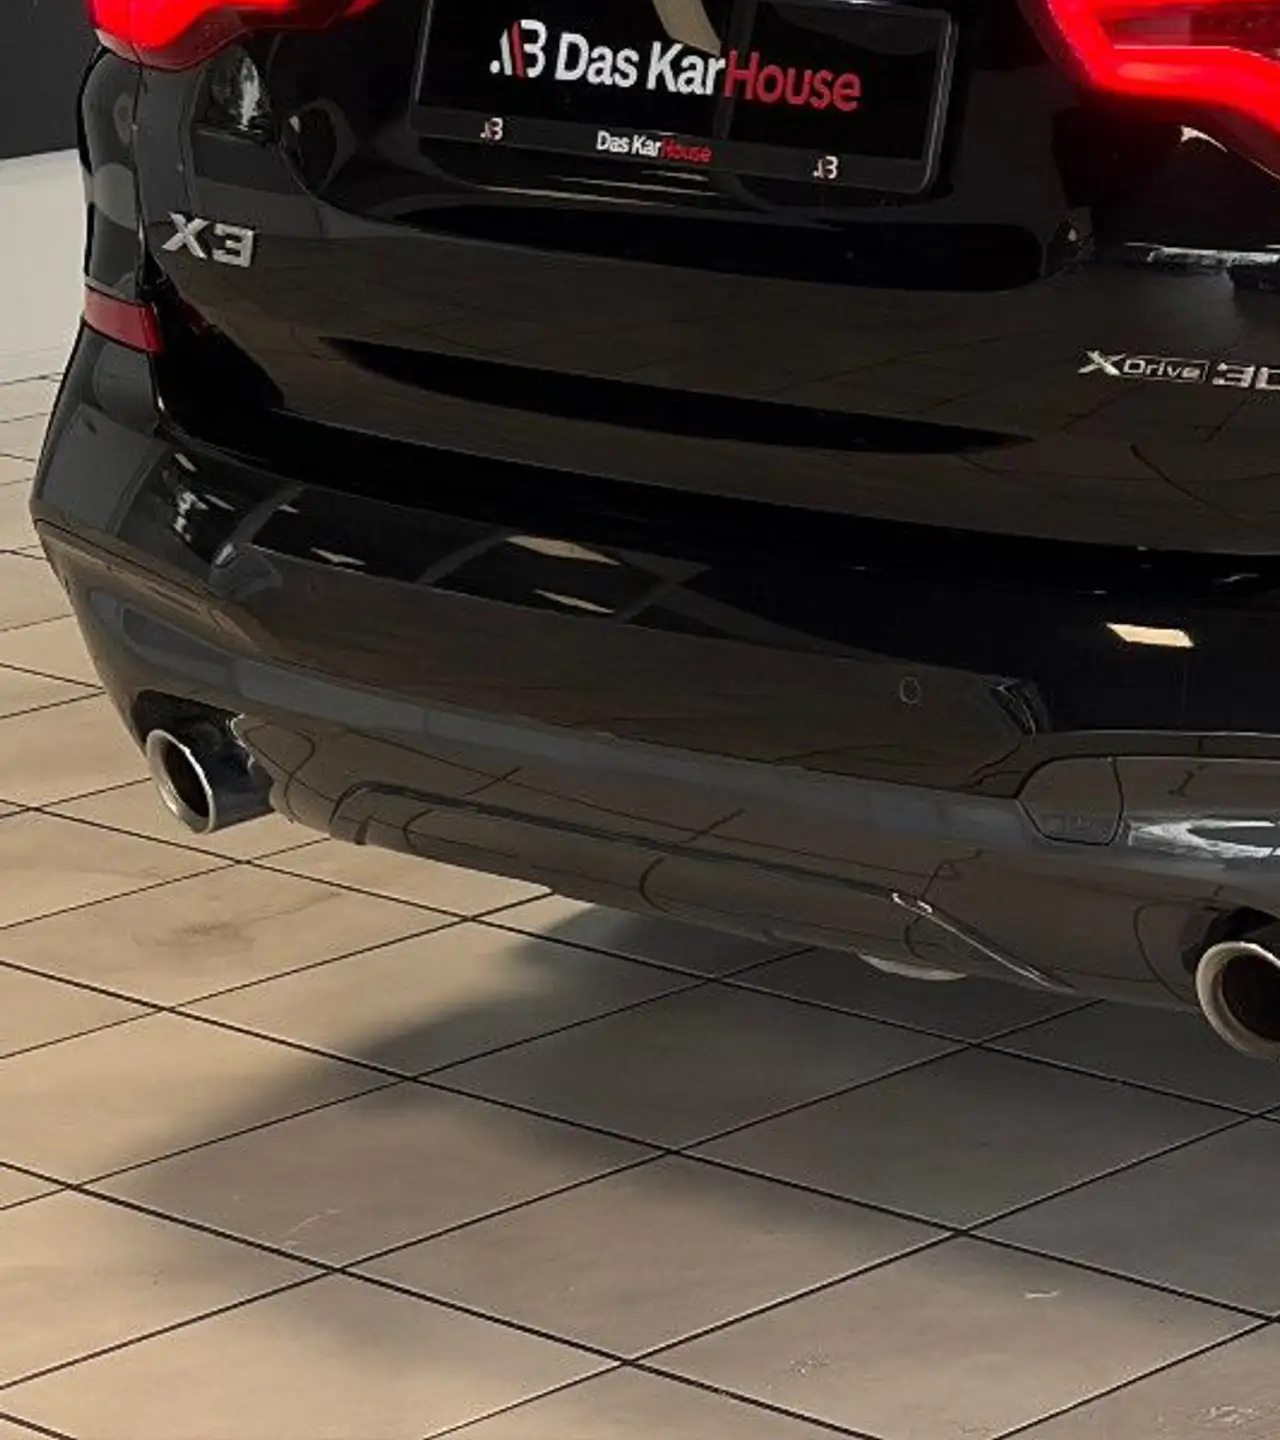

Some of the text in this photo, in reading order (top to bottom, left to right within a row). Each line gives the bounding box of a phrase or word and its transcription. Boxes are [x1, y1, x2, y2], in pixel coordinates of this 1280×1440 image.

[555, 33, 639, 88] Das
[597, 130, 629, 154] Das
[162, 211, 254, 268] X3
